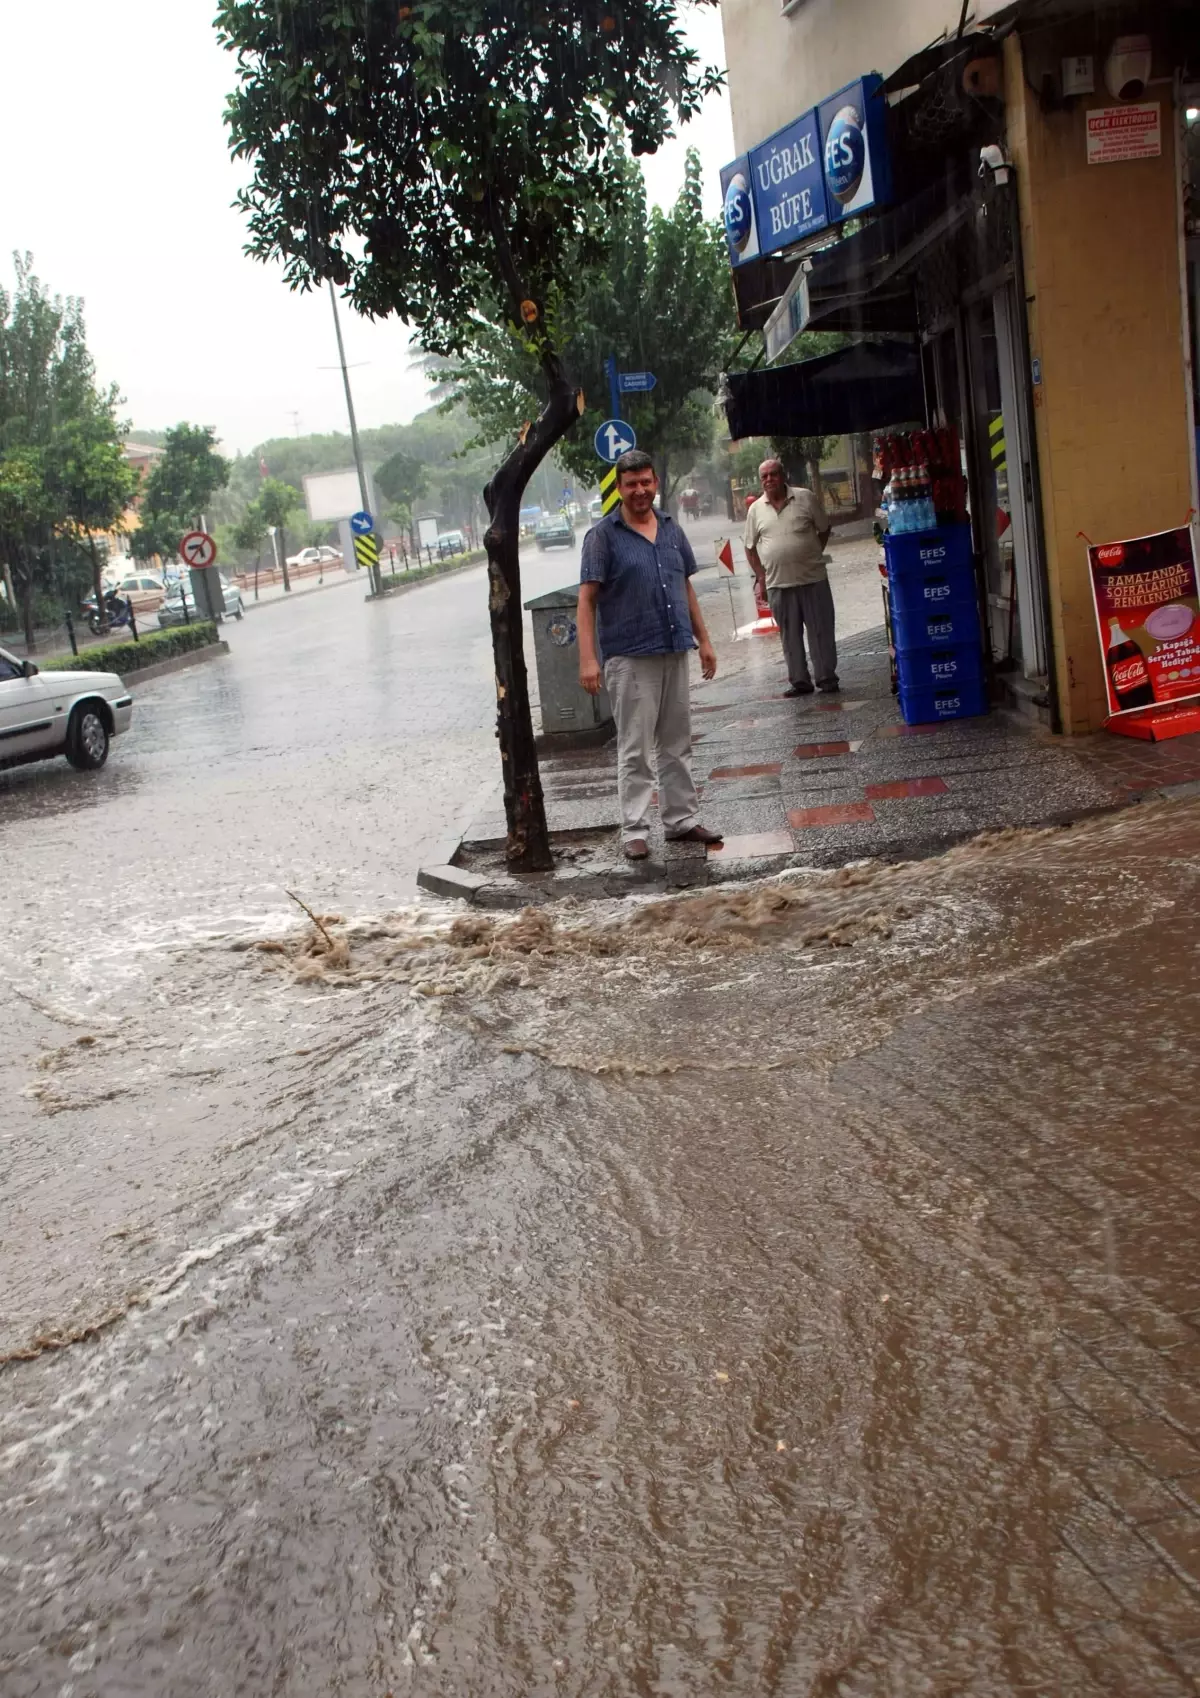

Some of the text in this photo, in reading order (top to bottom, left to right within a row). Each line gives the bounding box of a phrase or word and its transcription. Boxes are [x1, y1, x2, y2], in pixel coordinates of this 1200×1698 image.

[758, 133, 815, 191] UĞRAK
[770, 188, 812, 235] BÜFE
[920, 547, 946, 559] EFES
[1107, 563, 1184, 587] RAMAZANDA
[924, 585, 950, 598] EFES
[1106, 572, 1190, 598] SOFRALARINIZ
[928, 622, 953, 635] EFES
[1147, 651, 1174, 664] Servis
[1161, 654, 1192, 668] Hediye!
[931, 661, 957, 673] EFES
[935, 698, 960, 709] EFES
